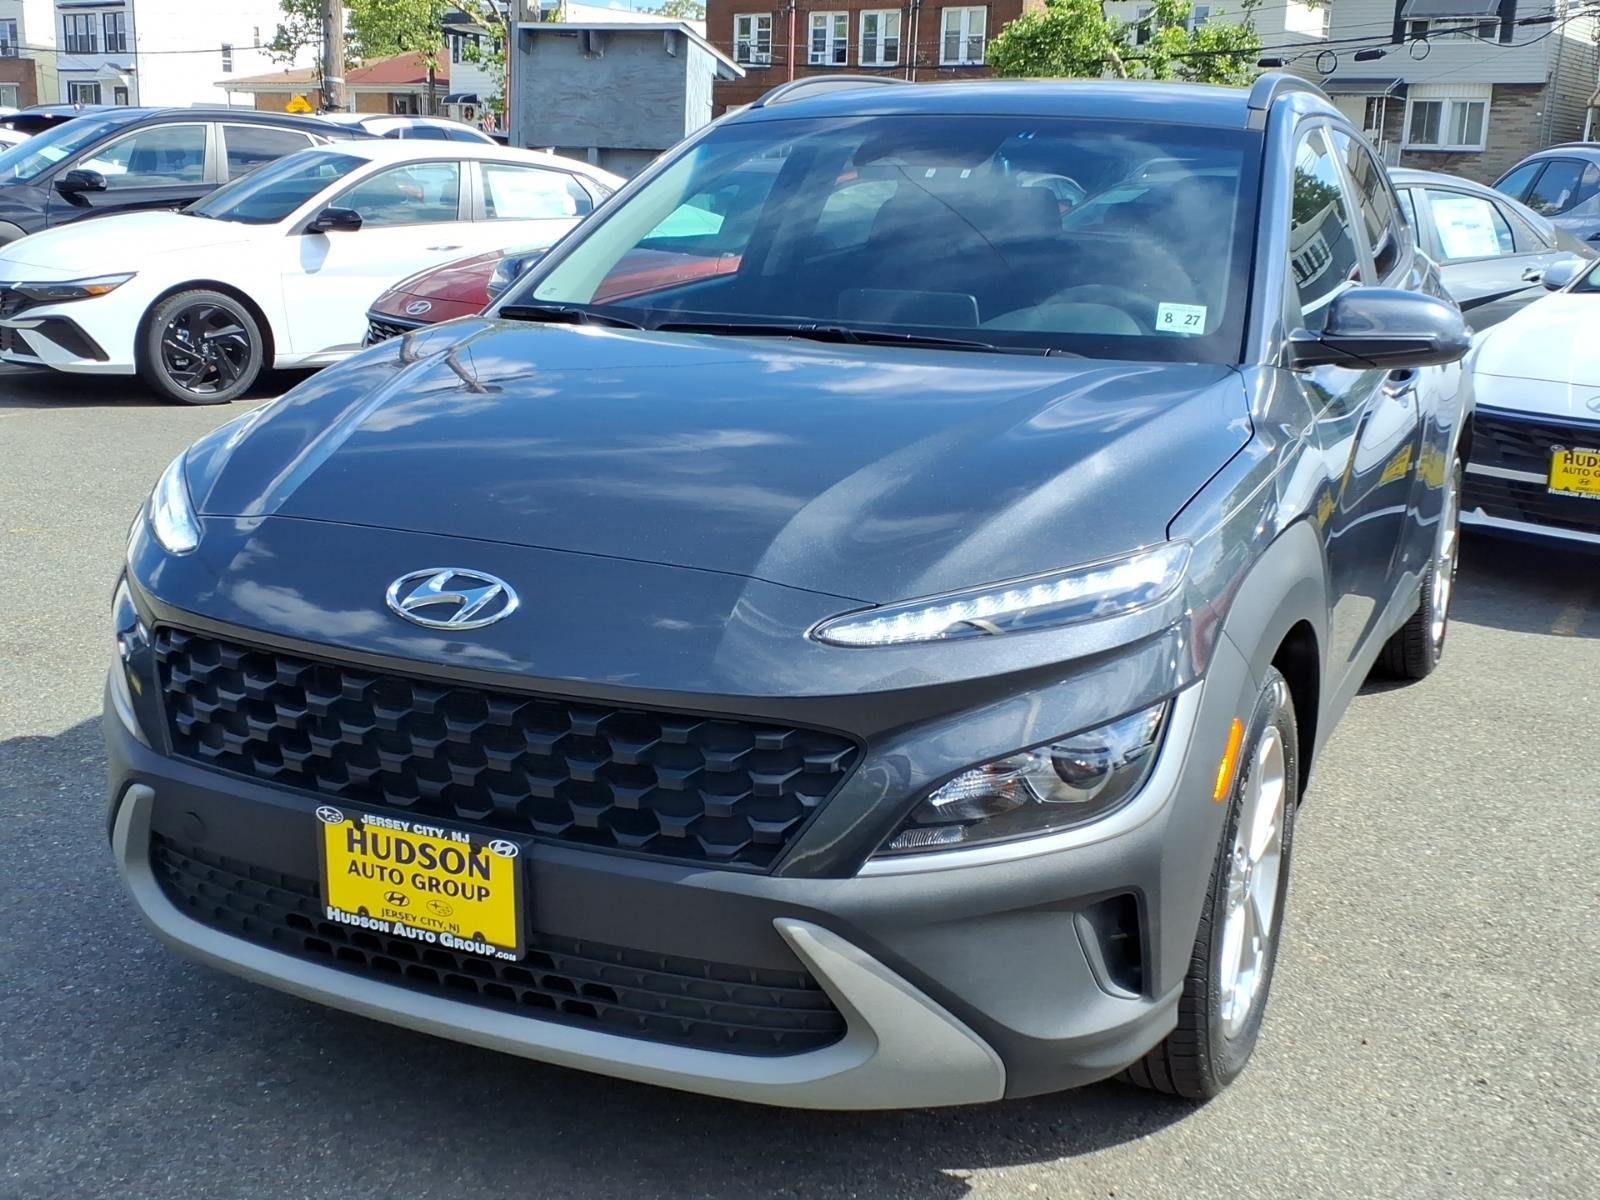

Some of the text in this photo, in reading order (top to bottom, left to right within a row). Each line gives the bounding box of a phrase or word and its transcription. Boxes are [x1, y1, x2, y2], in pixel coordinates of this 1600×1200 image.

[1165, 312, 1200, 325] 8 27
[1562, 467, 1590, 476] AUTO
[361, 814, 470, 843] JERSEY CITY, NJ
[346, 828, 491, 881] HUDSON
[348, 859, 490, 902] AUTO GROUP
[381, 908, 460, 934] JERSEY CITY, NJ
